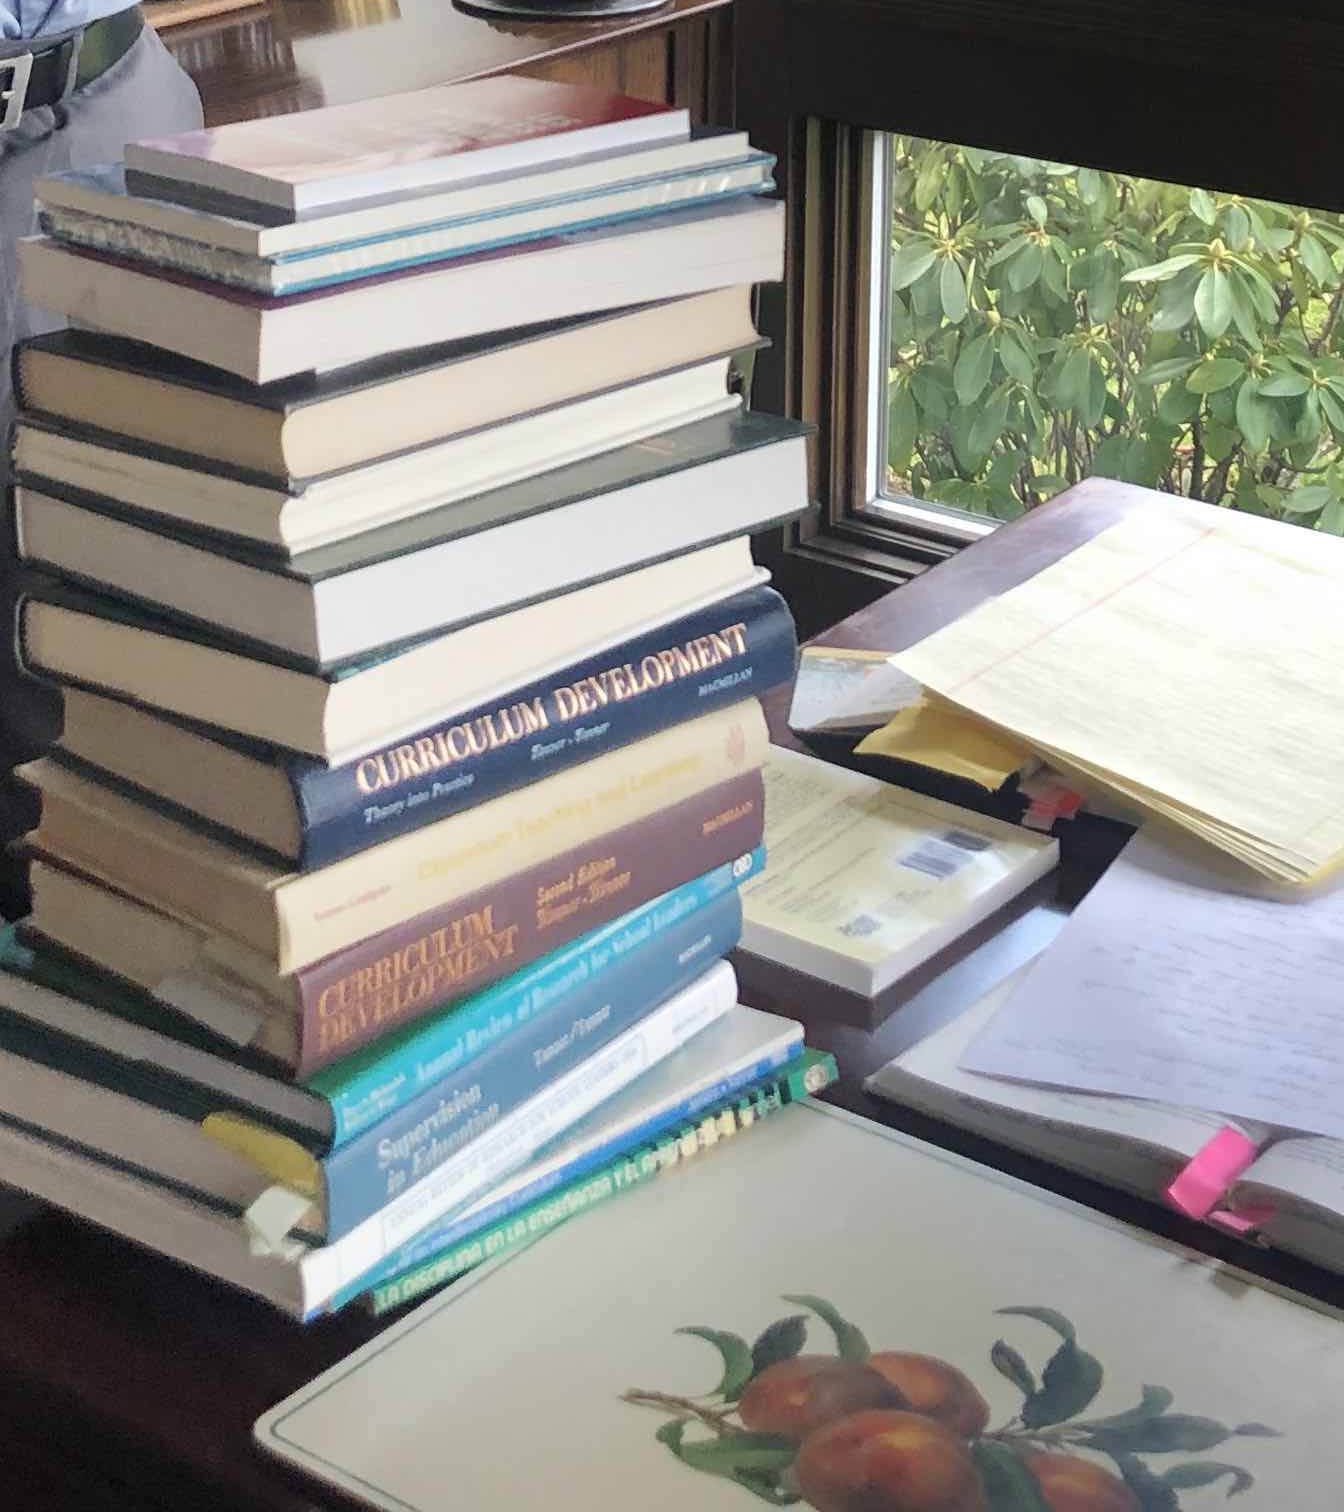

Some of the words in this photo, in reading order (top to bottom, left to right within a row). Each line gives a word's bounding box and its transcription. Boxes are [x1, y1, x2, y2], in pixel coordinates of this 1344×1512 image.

[356, 696, 549, 794] CURRICULUM
[554, 623, 747, 720] DEVELOPMENT
[698, 667, 753, 696] MACMILLAN
[318, 904, 494, 1017] CURRICULUM
[319, 924, 519, 1057] DEVELOPMENT
[378, 1085, 482, 1170] Supervision
